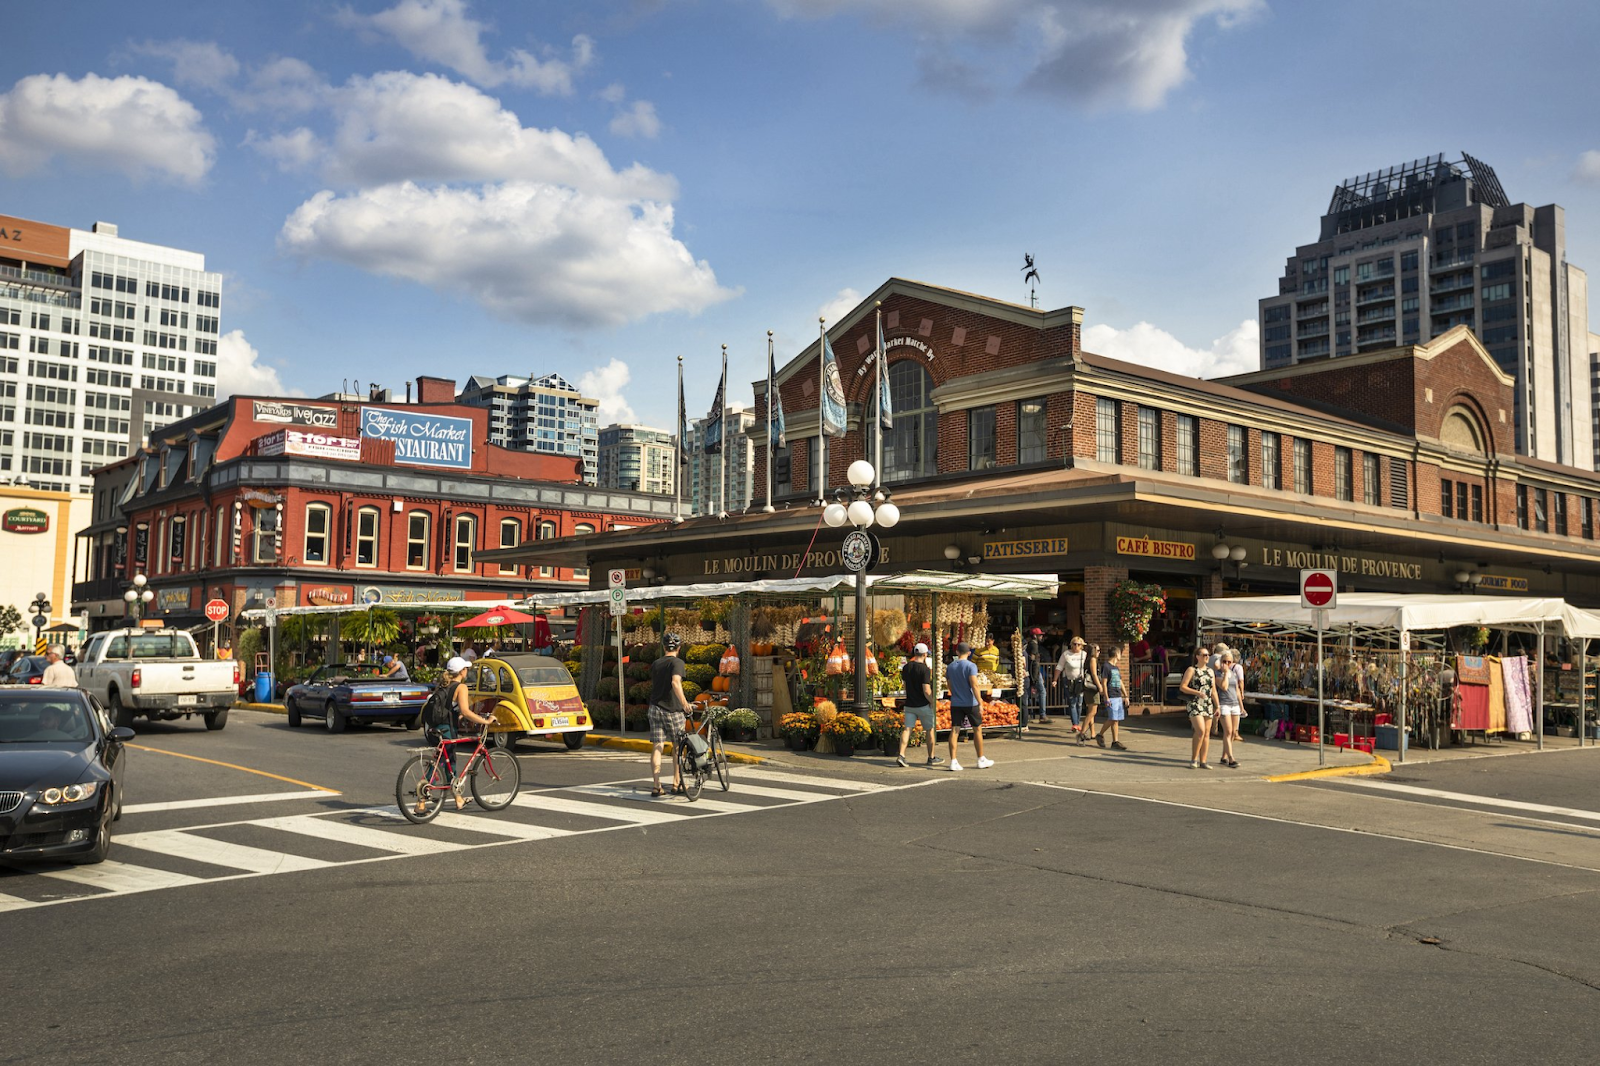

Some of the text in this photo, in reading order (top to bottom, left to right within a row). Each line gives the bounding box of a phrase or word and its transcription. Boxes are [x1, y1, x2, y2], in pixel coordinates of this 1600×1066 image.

[365, 410, 386, 423] The
[287, 431, 302, 442] 2
[303, 433, 337, 446] for
[337, 437, 347, 448] 1
[366, 417, 467, 441] Fish Market
[381, 436, 464, 462] STAURANT
[985, 539, 1066, 557] PATISSERIE
[1117, 535, 1194, 559] CAFÉ BISTRO
[704, 559, 720, 575] LE
[724, 554, 778, 574] MOULIN
[782, 553, 800, 570] DE
[1263, 547, 1422, 580] LE MOULIN DE PROVENCE
[207, 605, 227, 615] STOP
